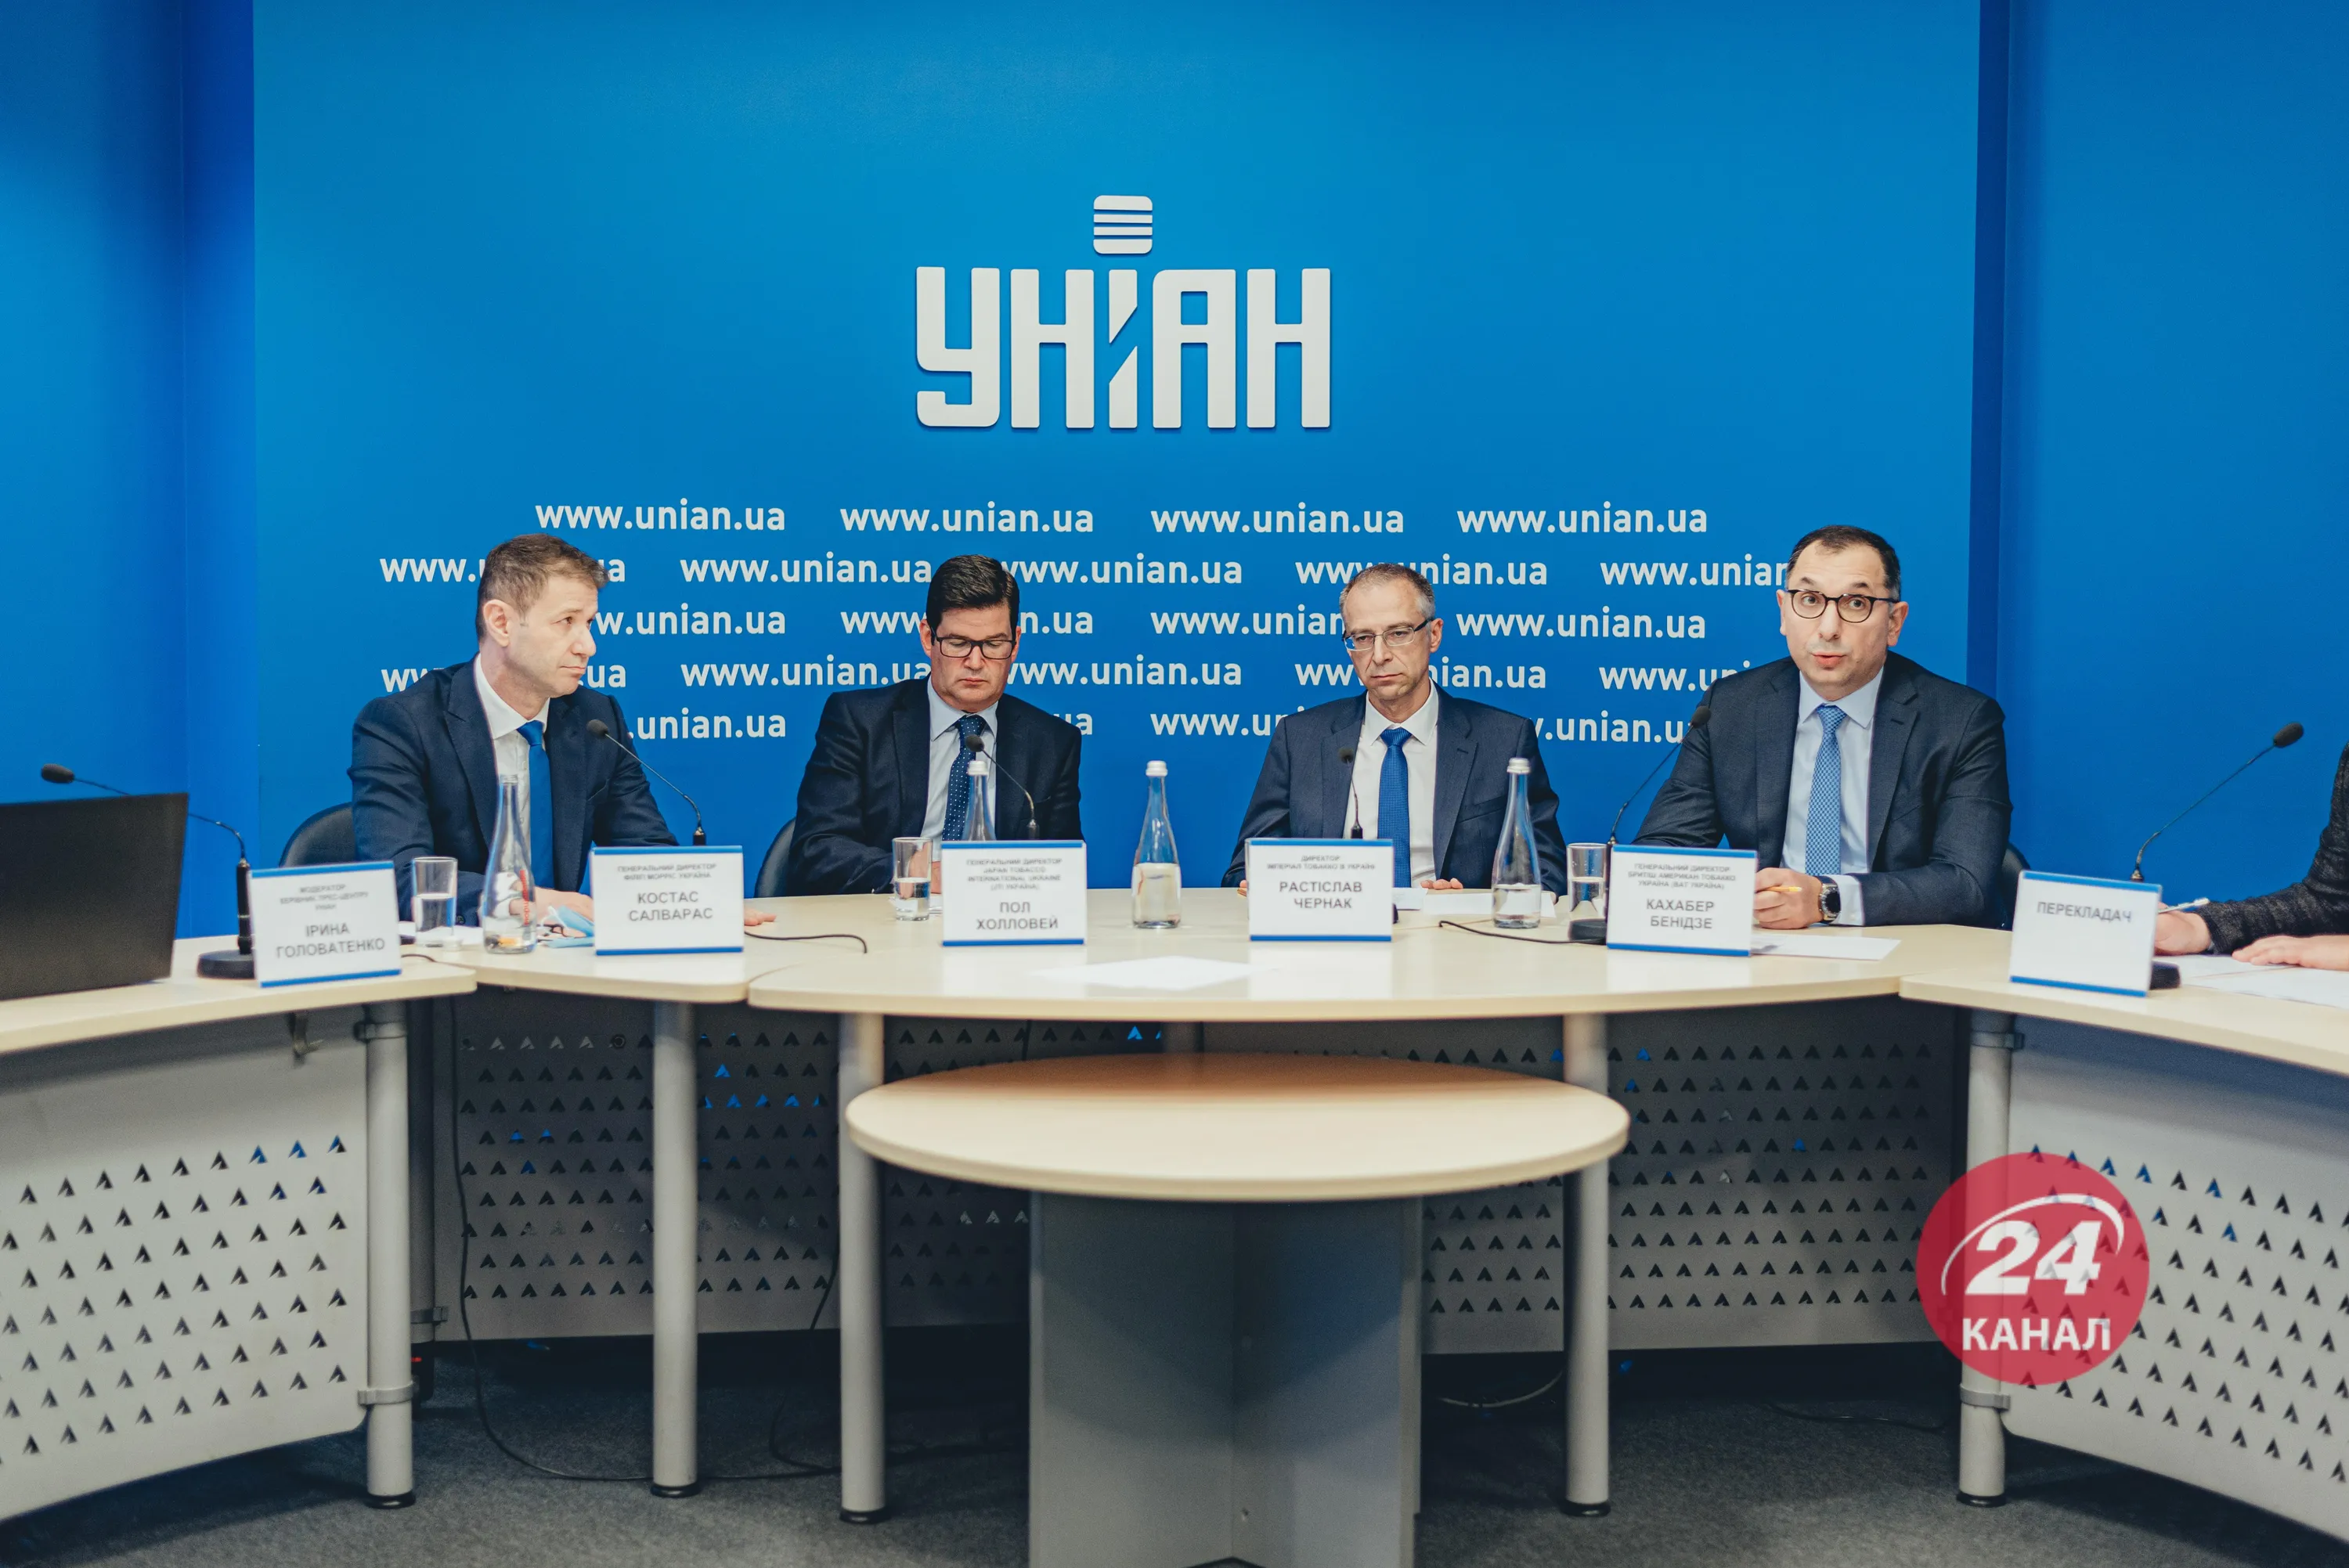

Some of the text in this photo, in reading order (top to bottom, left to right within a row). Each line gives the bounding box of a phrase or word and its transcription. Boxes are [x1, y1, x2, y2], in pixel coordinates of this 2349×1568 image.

[536, 498, 1707, 533] www.unian.ua www.unian.ua www.unian.ua www.unian.ua
[680, 551, 932, 582] www.unian.ua
[1003, 553, 1242, 584] ww.unian.ua
[593, 603, 785, 635] w.unian.ua
[1456, 605, 1705, 638] www.unian.ua
[630, 708, 786, 739] .unian.ua
[1279, 881, 1363, 893] РАСТІСЛАВ
[637, 891, 699, 904] КОСТАС
[1294, 897, 1352, 909] ЧЕРНАК
[999, 901, 1031, 914] ПОЛ
[1646, 899, 1715, 912] КАХАБЕР
[2037, 901, 2132, 923] ПЕРЕКЛАДАЧ
[628, 907, 713, 922] САЛВАРАС
[305, 922, 350, 937] ІРИНА
[976, 915, 1059, 930] ХОЛЛОВЕЙ
[1650, 915, 1713, 930] БЕНІДЗЕ
[276, 938, 386, 959] ГОЛОВАТЕНКО
